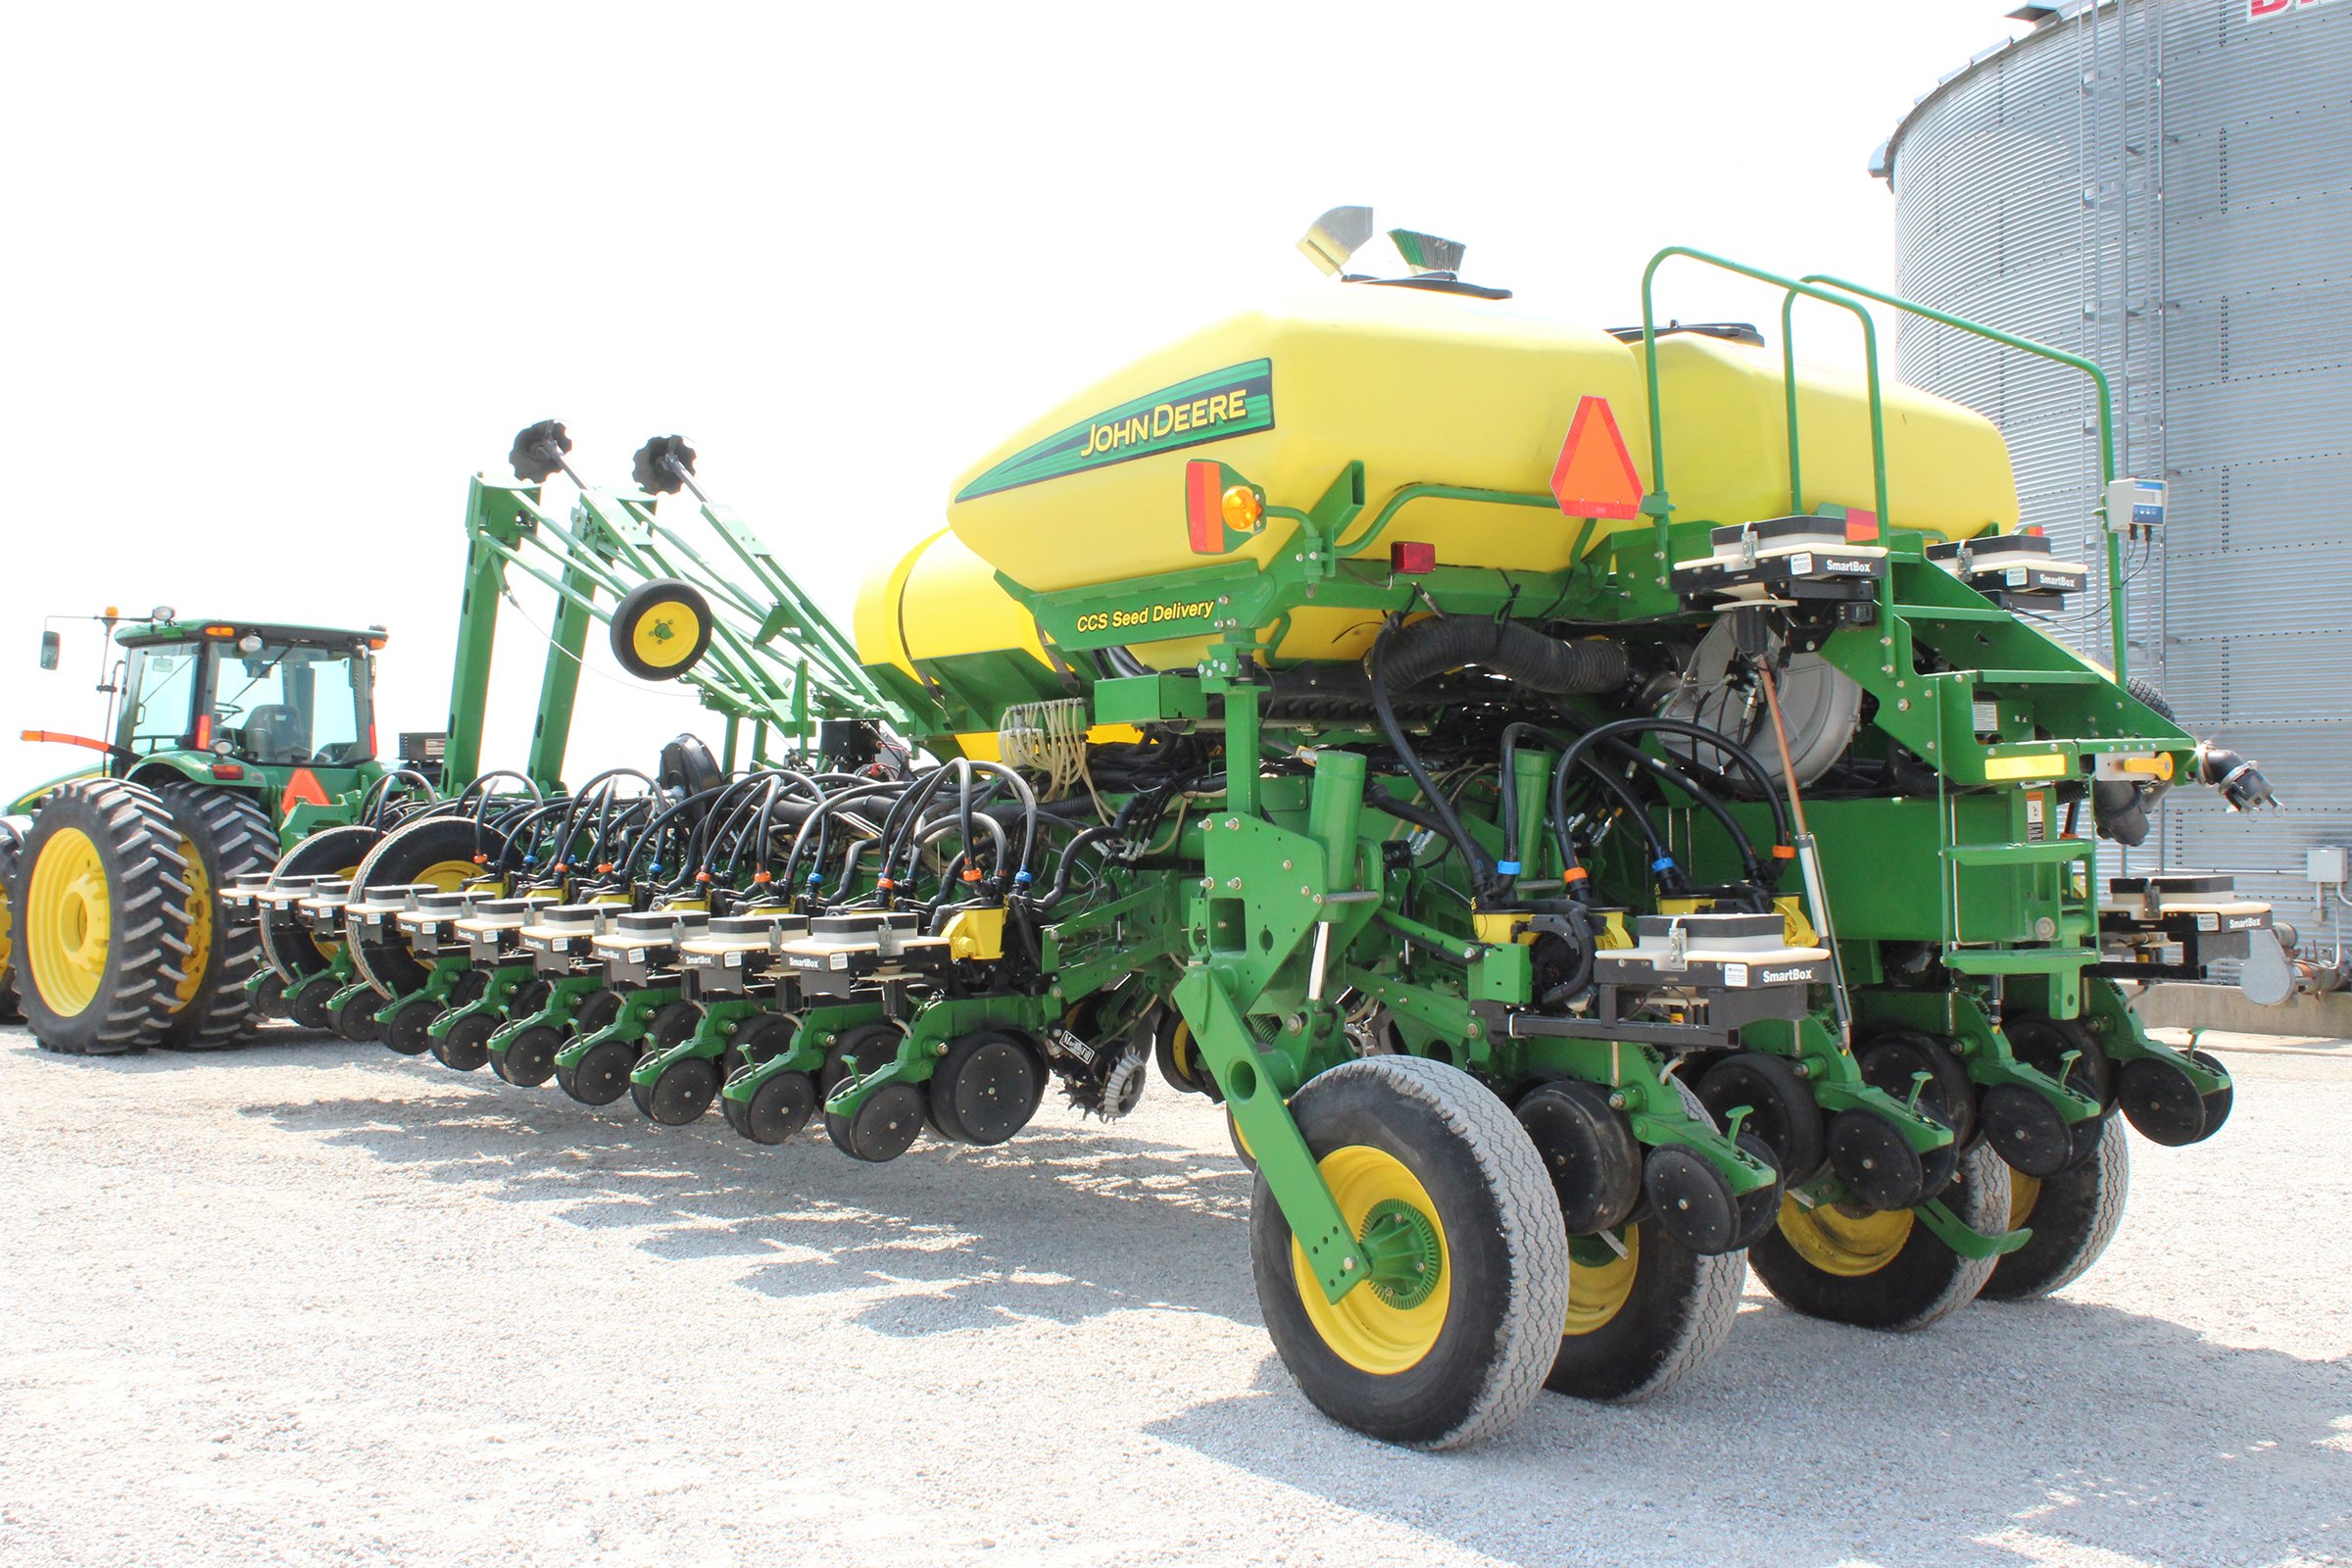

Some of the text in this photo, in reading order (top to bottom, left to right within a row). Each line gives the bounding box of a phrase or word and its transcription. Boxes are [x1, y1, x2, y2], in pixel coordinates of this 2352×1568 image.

[1081, 389, 1248, 457] JOHN DEERE
[1826, 560, 1871, 572] SmartBox
[2039, 573, 2075, 587] SmartBox
[1077, 601, 1215, 632] CCS Seed Delivery
[2229, 917, 2261, 929] SmartBox
[789, 956, 819, 968] SmartBox
[1763, 968, 1812, 983] SmartBox
